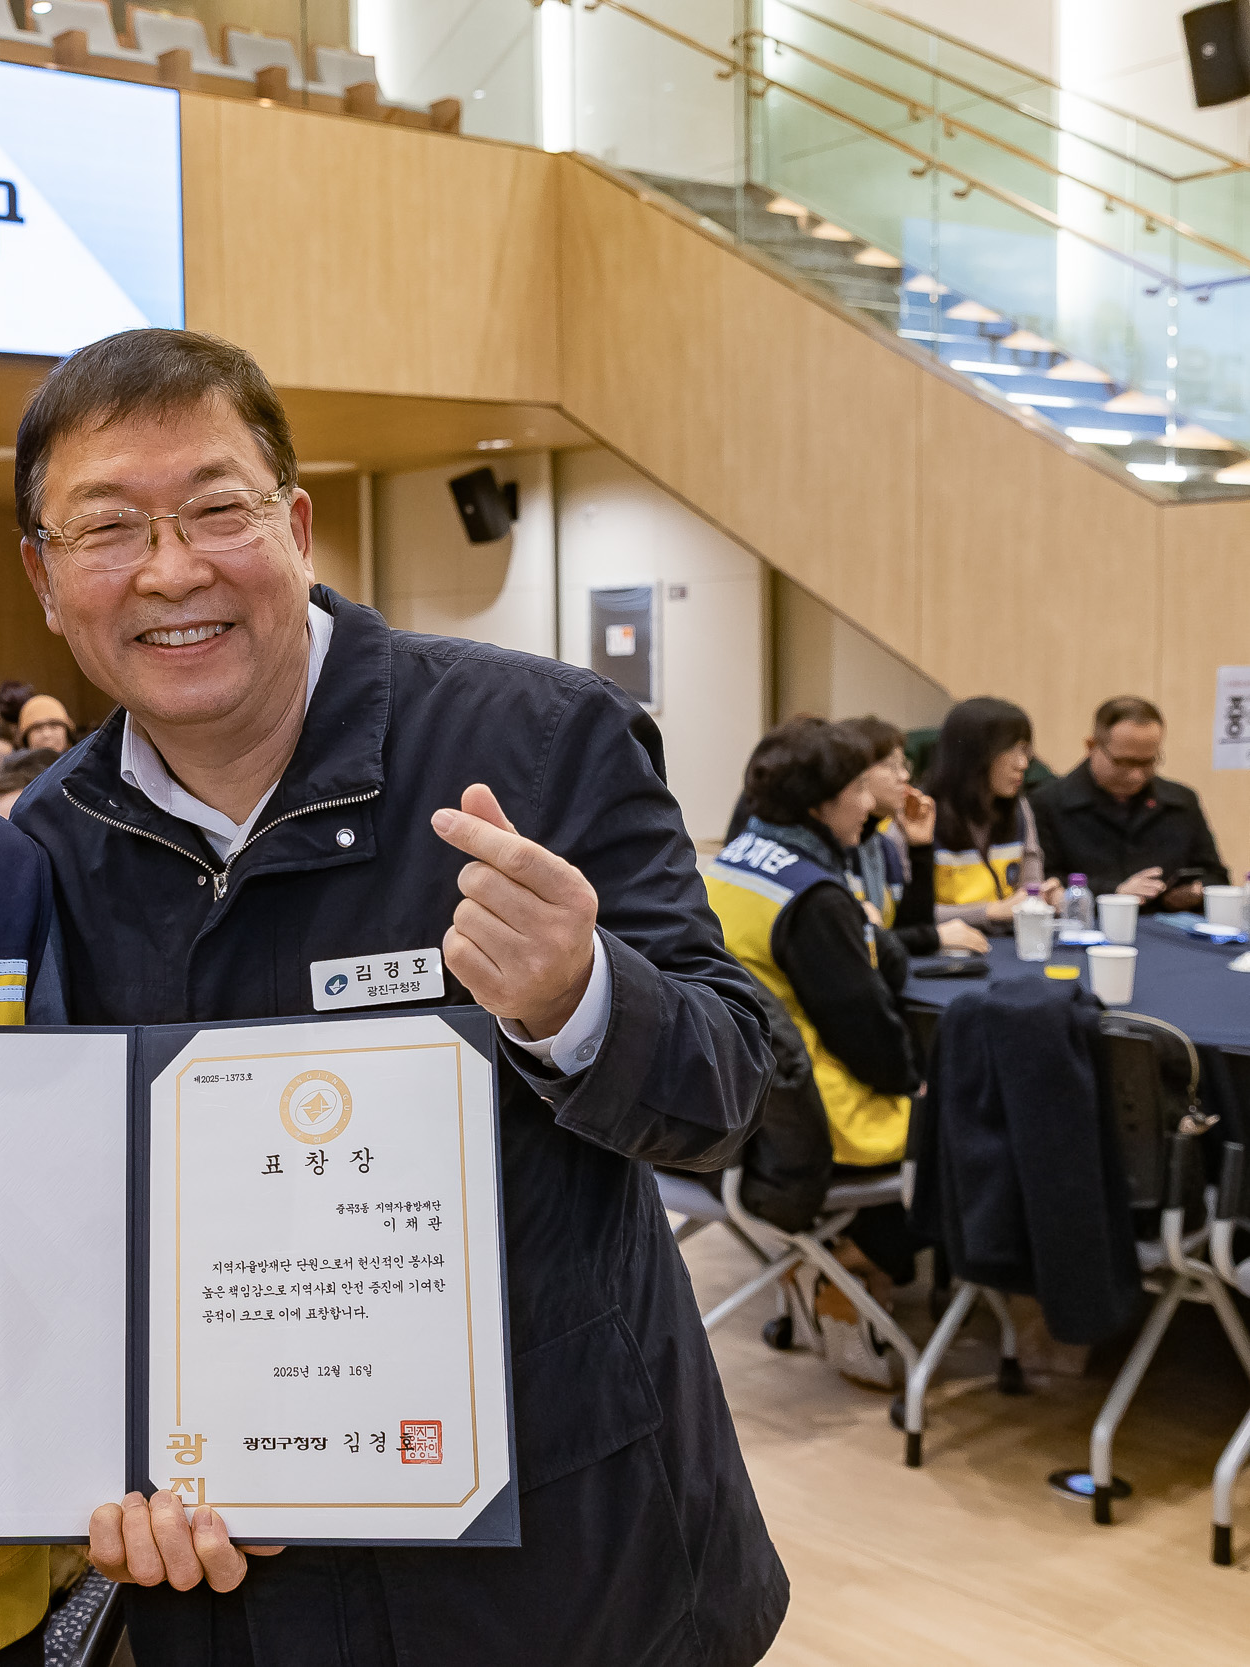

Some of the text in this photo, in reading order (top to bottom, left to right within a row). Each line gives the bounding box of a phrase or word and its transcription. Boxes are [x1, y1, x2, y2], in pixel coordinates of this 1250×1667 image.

[367, 981, 421, 997] 광진구청장
[193, 1072, 253, 1084] 제2025-1373호
[335, 1200, 442, 1215] 중곡3동 지역자율방재단
[212, 1253, 445, 1275] 지역자율방재단 단원으로서 헌신적인 봉사와
[202, 1278, 446, 1300] 높은 책임감으로 지역사회 안전 증진에 기여한
[202, 1305, 369, 1324] 공적이 크므로 이에 표창합니다.
[273, 1363, 372, 1378] 2025년 12월 16일
[242, 1436, 329, 1451] 광진구청장
